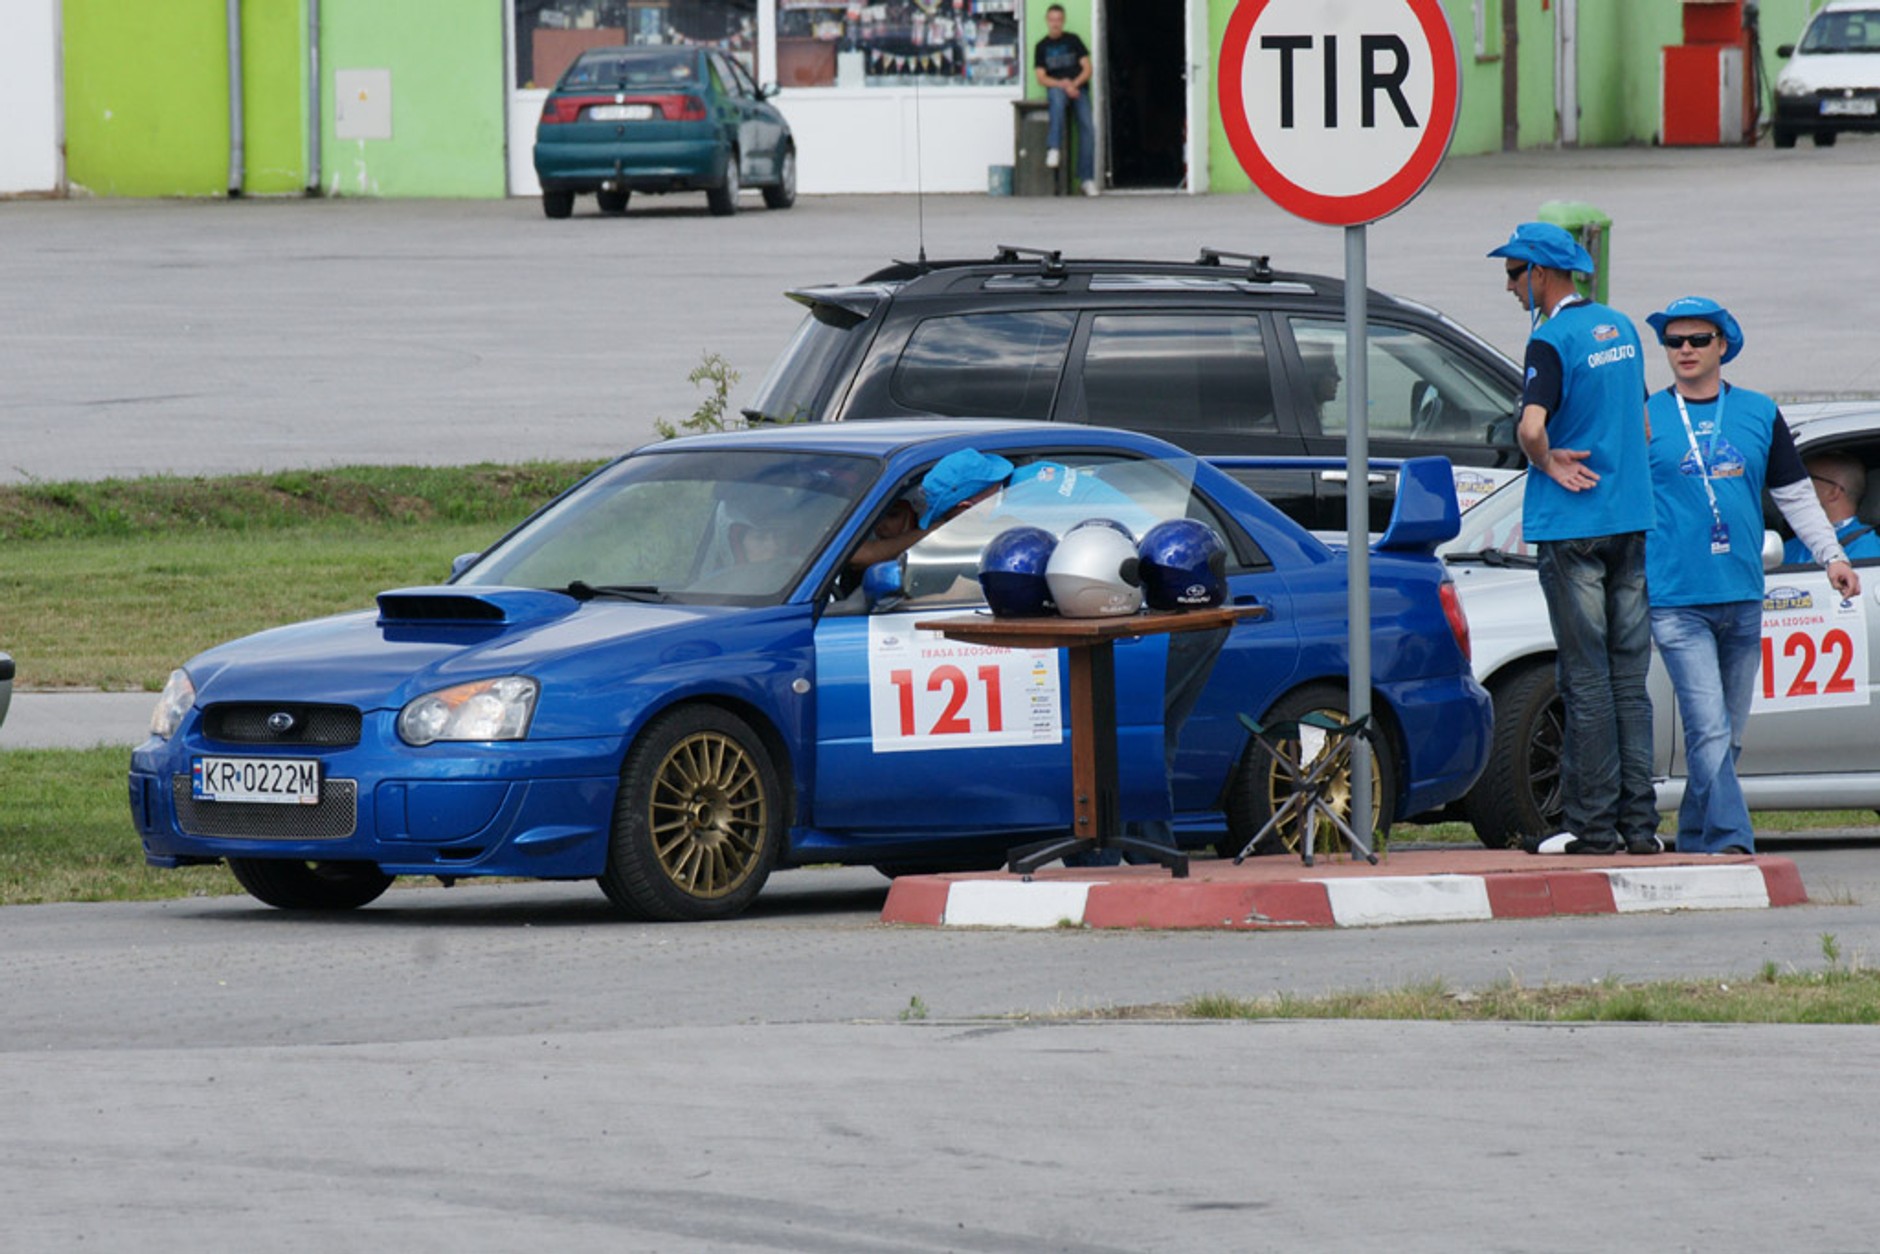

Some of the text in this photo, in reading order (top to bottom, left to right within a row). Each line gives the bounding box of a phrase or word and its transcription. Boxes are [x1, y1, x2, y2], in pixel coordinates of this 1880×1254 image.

[1260, 34, 1420, 129] TIR
[1760, 627, 1856, 699] 122
[890, 664, 1003, 737] 121
[205, 762, 314, 795] KR 0222M
